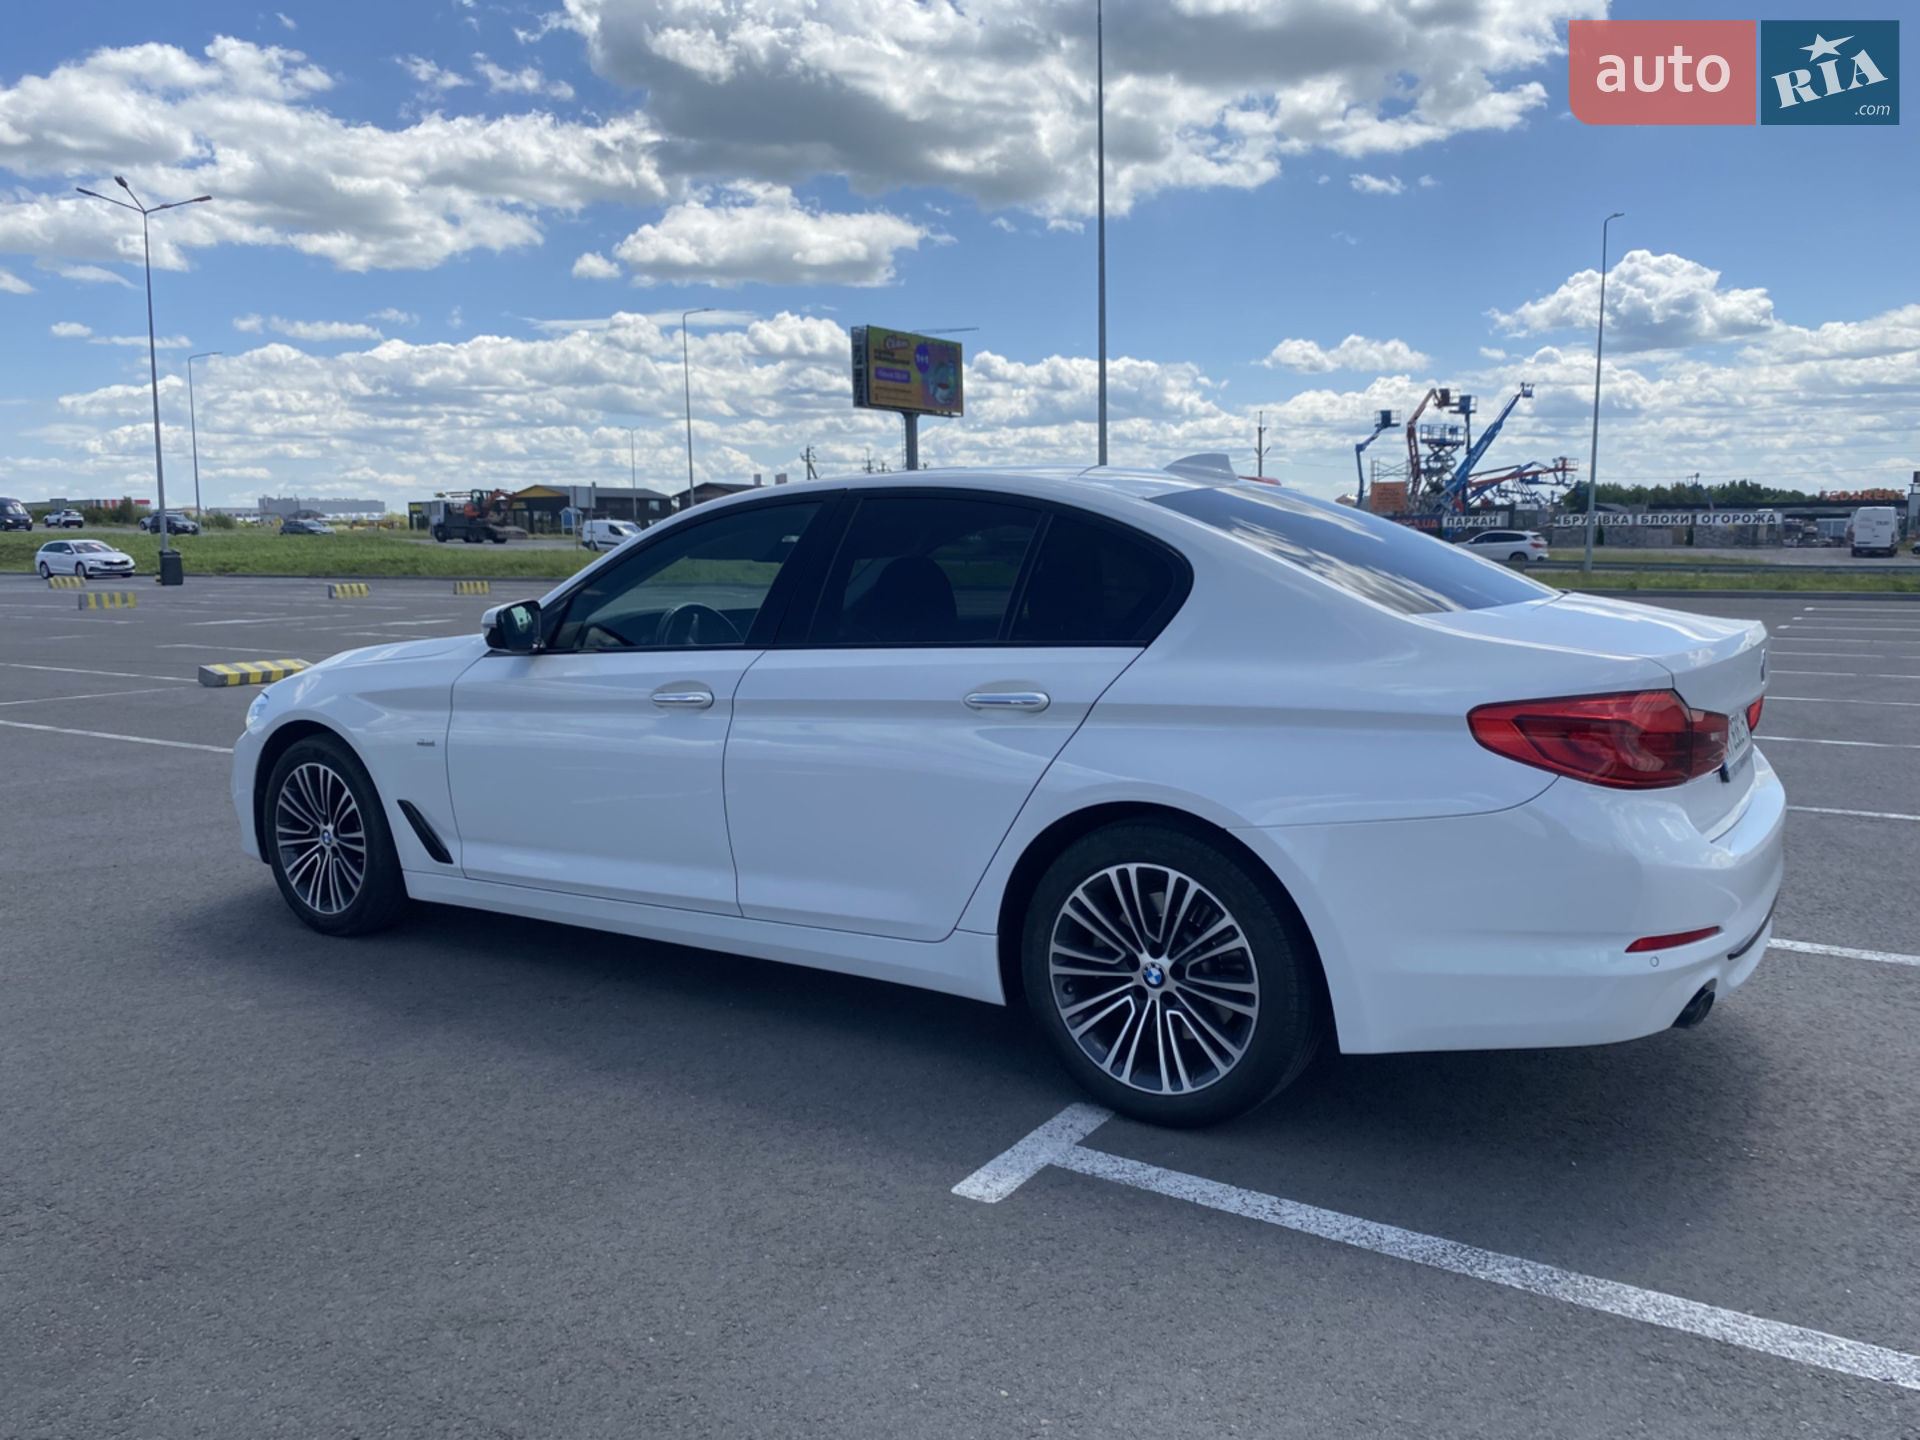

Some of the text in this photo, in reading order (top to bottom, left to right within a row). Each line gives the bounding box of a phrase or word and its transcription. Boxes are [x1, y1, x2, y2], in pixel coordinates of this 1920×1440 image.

[1446, 516, 1498, 526] ПАРКАН
[1640, 514, 1690, 525] БЛОКИ
[1701, 513, 1777, 525] ОГОРОЖА
